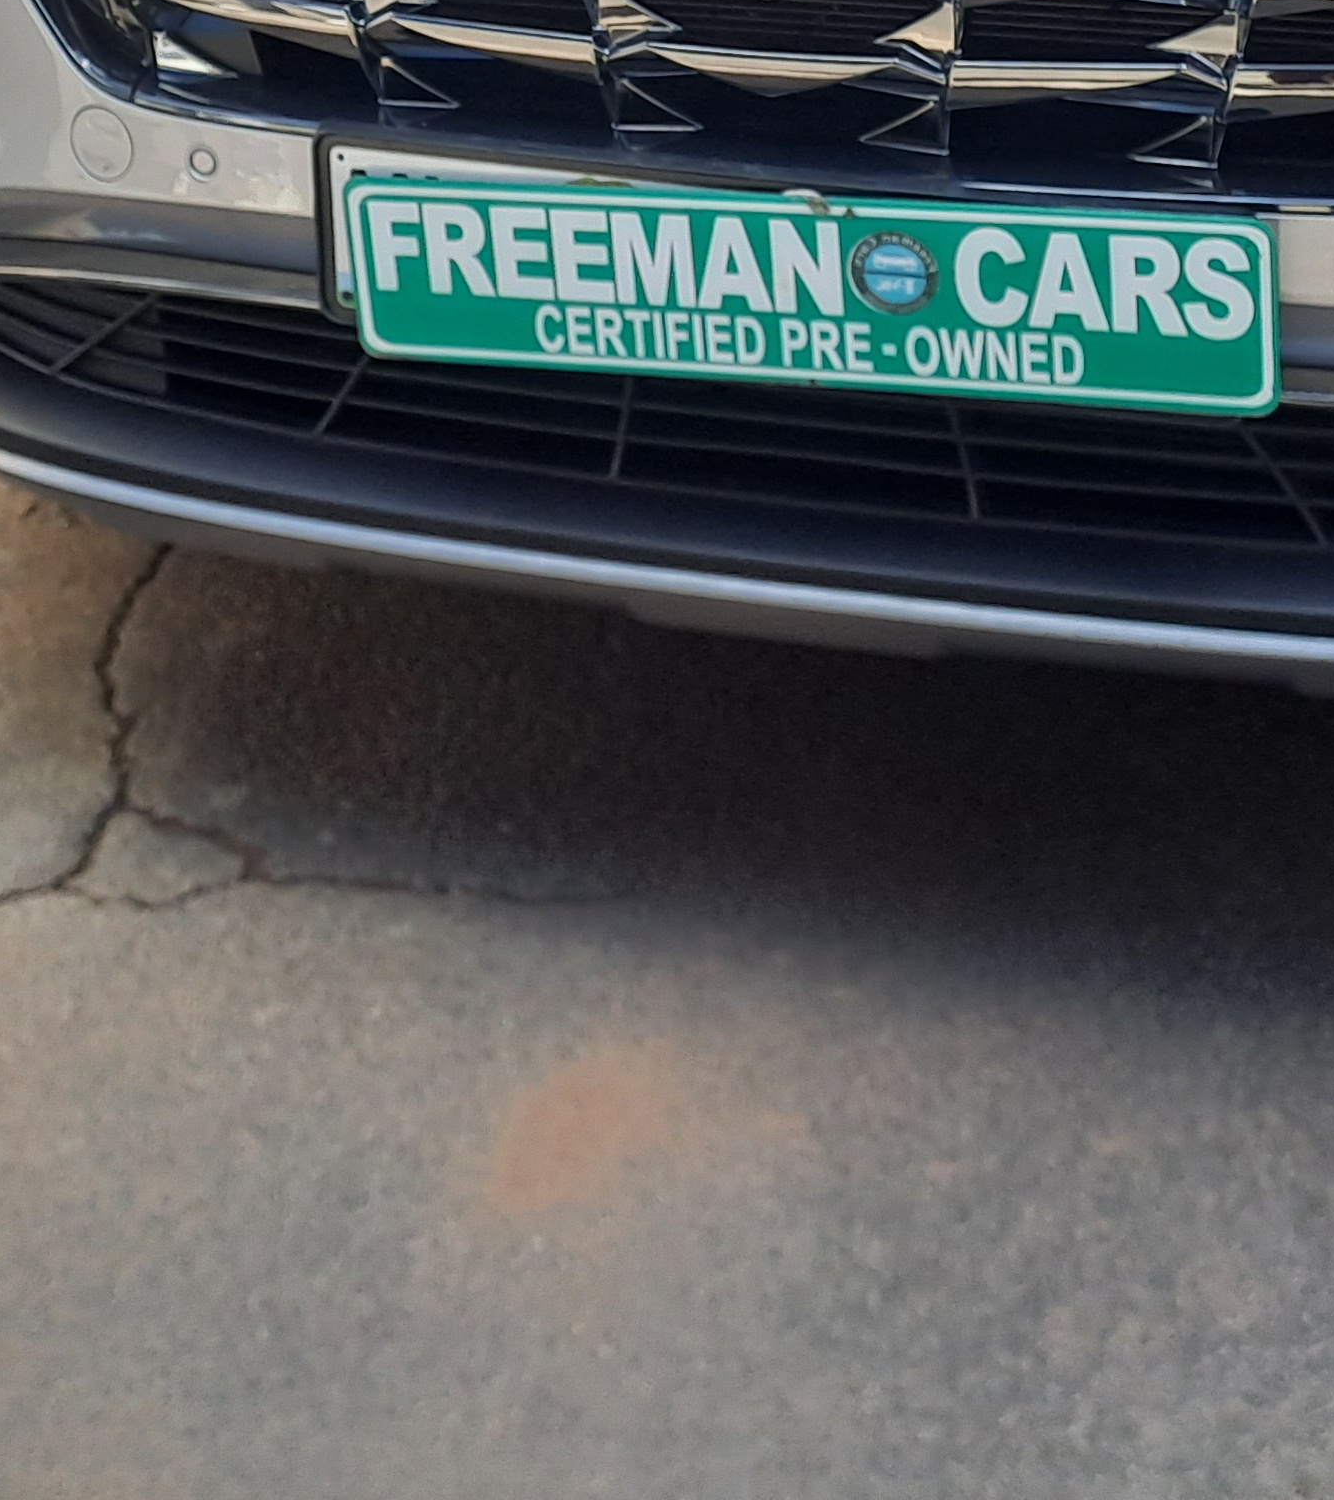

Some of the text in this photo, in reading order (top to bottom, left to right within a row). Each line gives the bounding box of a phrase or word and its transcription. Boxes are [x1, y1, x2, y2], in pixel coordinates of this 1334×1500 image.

[367, 200, 846, 318] FREEMAN
[954, 226, 1255, 342] CARS
[534, 304, 766, 366] CERTIFIED
